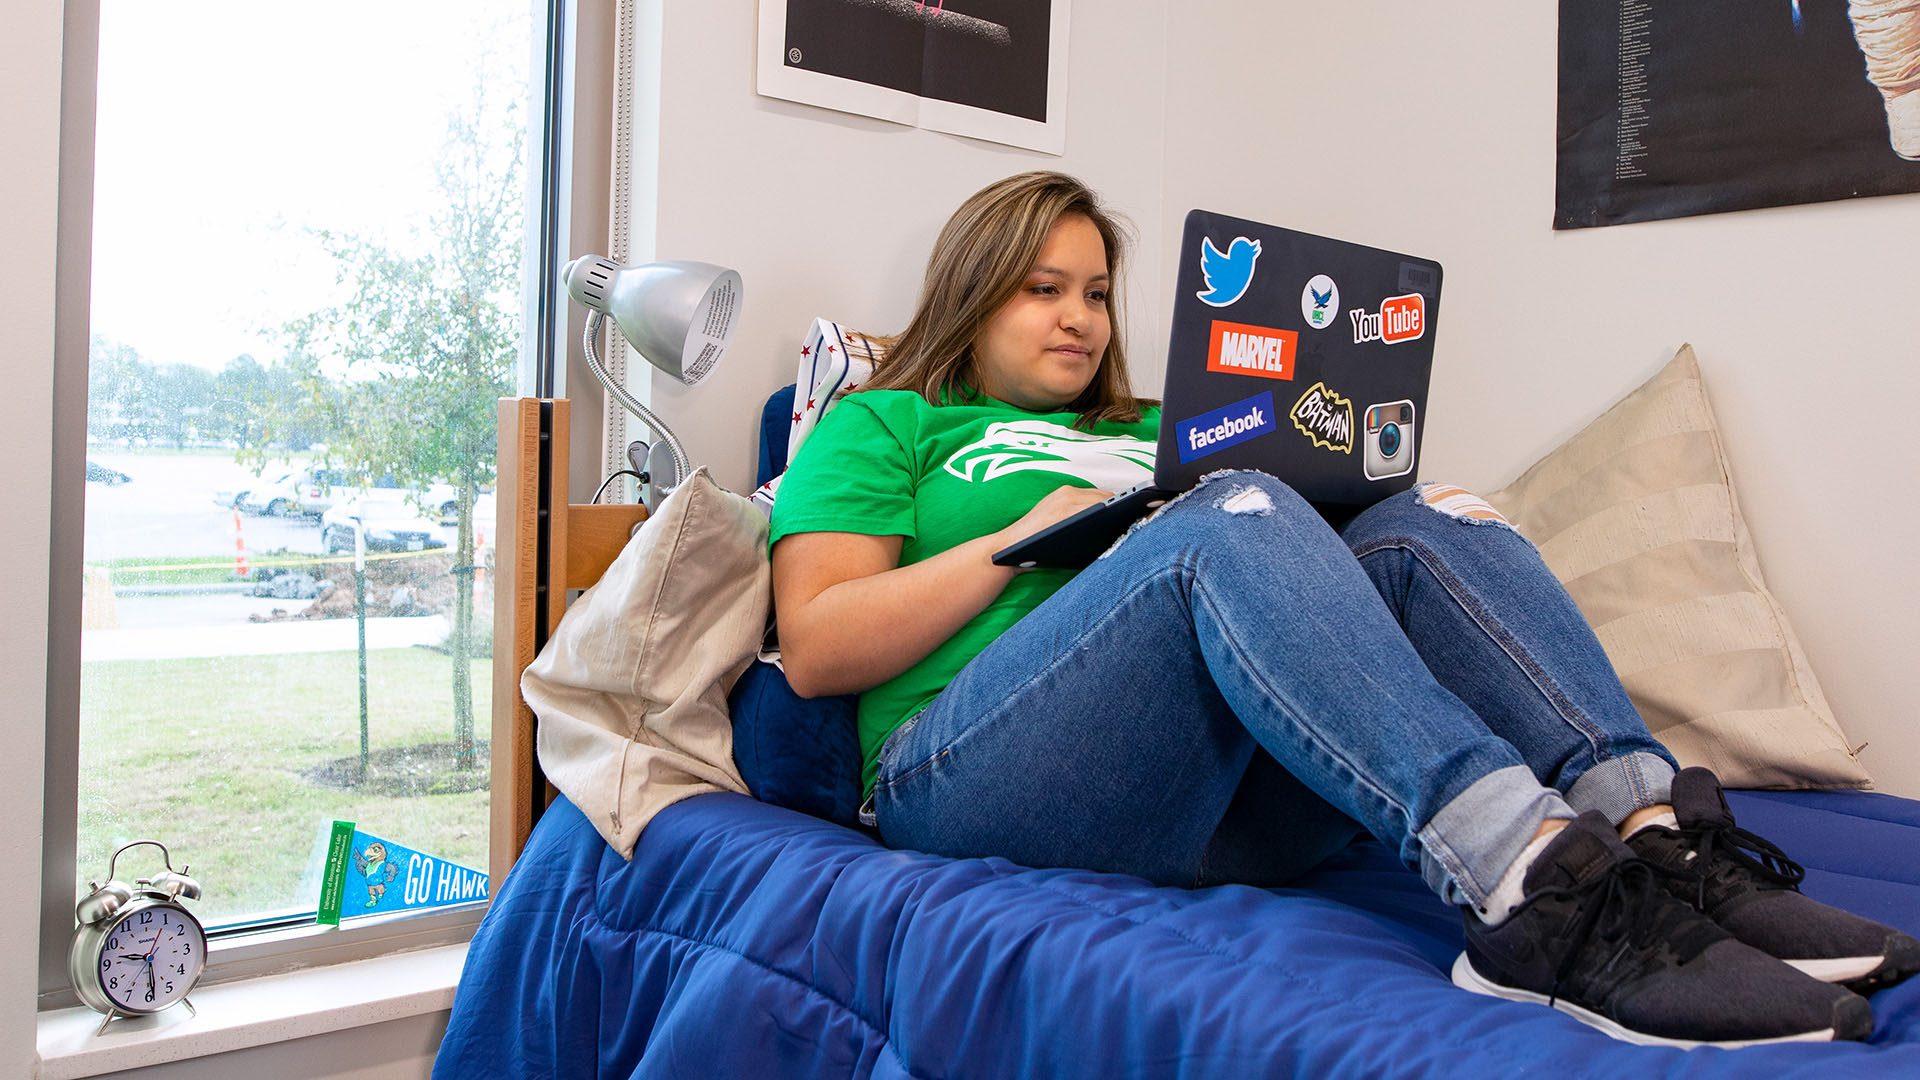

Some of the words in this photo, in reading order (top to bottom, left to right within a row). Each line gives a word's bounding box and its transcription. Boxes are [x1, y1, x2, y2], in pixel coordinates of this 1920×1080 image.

[1219, 331, 1283, 372] MARVEL
[1297, 391, 1349, 444] BATMAN
[1188, 406, 1265, 451] facebook
[404, 853, 433, 905] GO
[436, 862, 489, 902] HAWK
[140, 911, 153, 925] 12
[163, 913, 169, 925] 1
[120, 921, 131, 933] 11
[176, 924, 185, 936] 2
[105, 937, 119, 951] 10
[183, 943, 191, 955] 3
[103, 960, 111, 972] 9
[177, 964, 186, 976] 4
[109, 976, 118, 989] 8
[166, 982, 174, 994] 5
[125, 989, 133, 1003] 7
[145, 990, 154, 1003] 6
